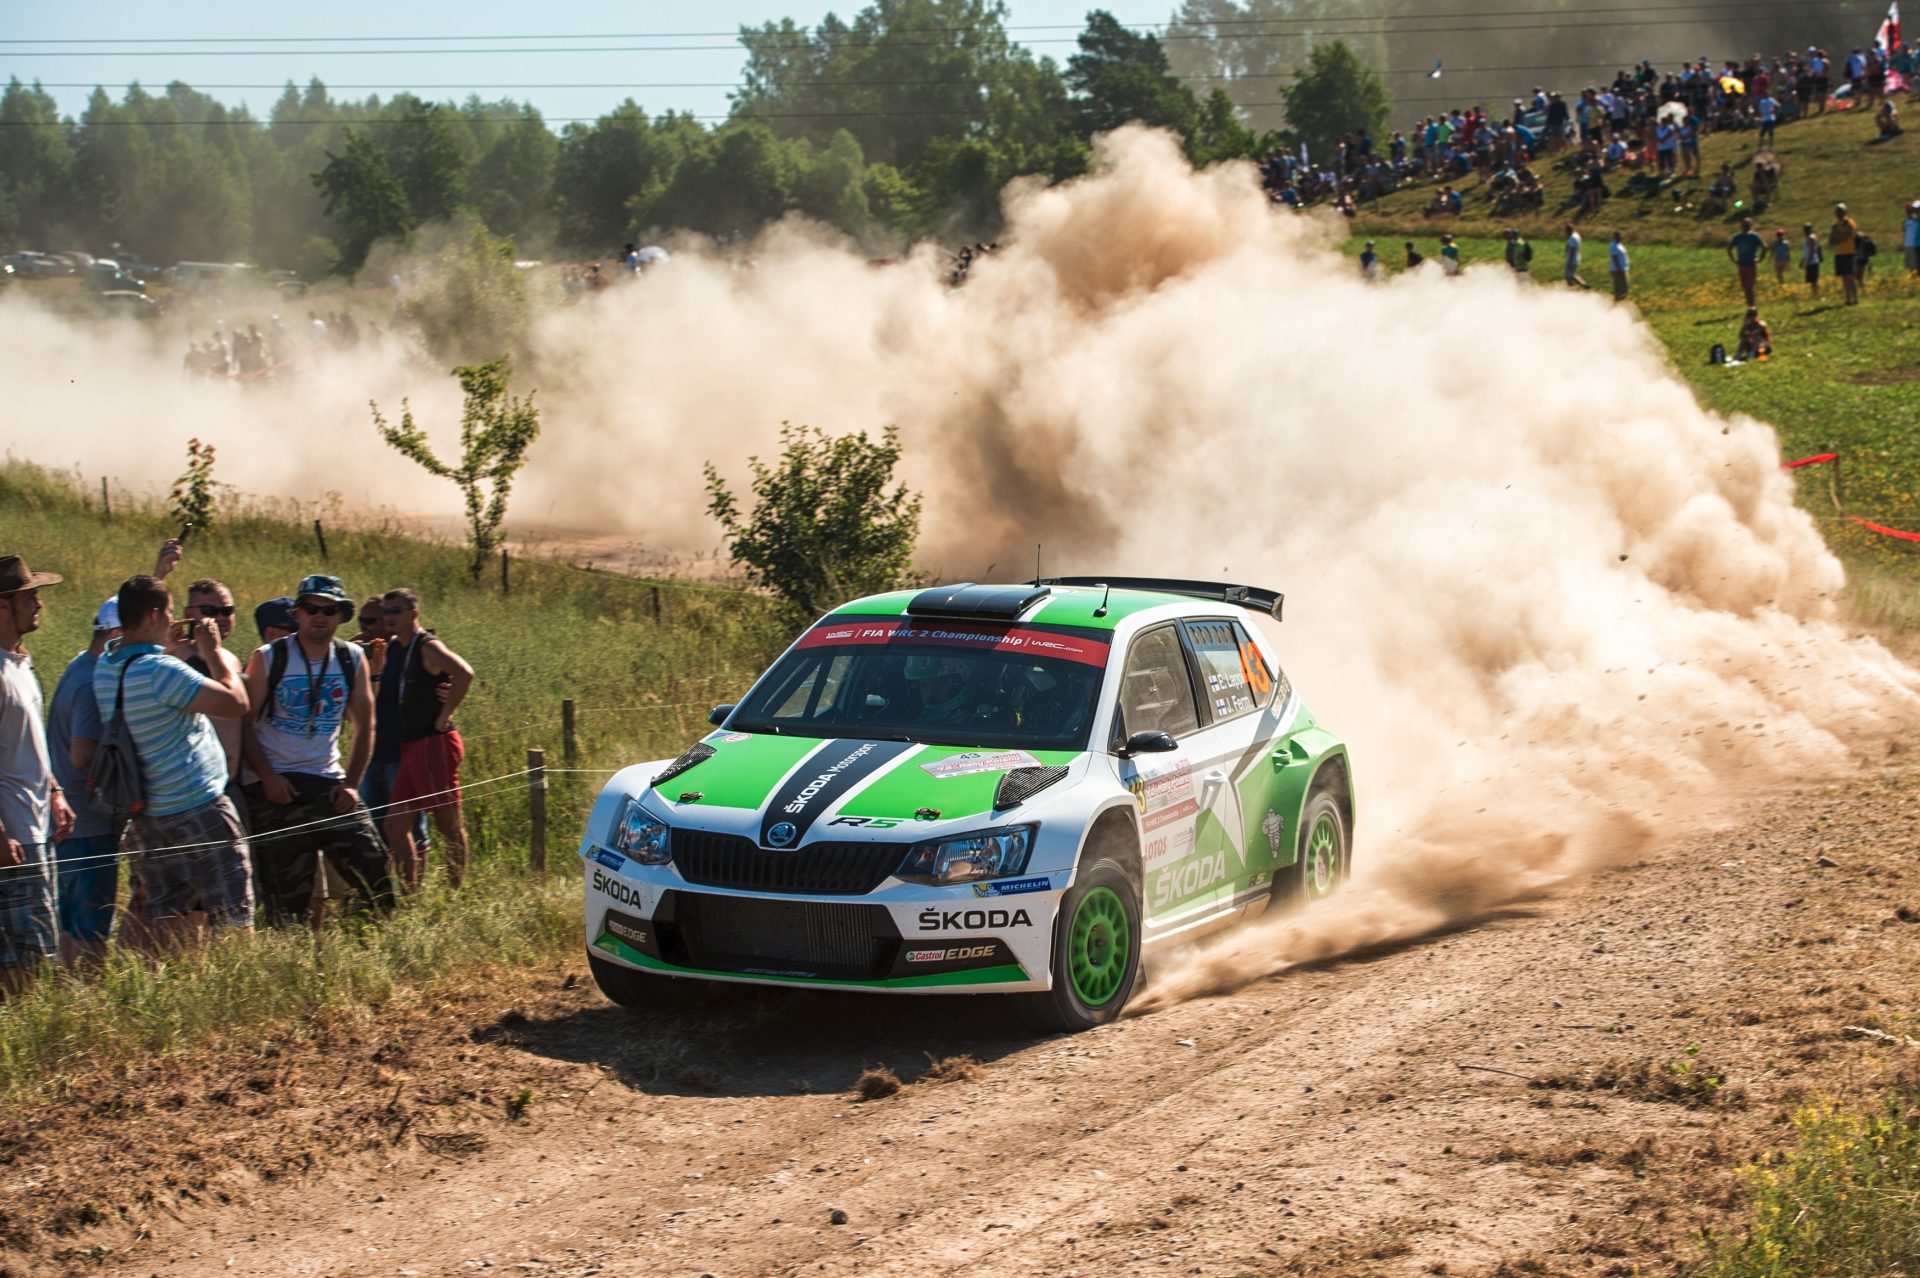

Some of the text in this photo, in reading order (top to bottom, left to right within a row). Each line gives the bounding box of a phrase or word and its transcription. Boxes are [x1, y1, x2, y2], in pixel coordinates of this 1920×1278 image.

[862, 629, 884, 637] FIA
[887, 629, 917, 637] WRC
[931, 630, 1023, 646] Championship
[960, 752, 981, 760] 43
[783, 743, 877, 813] ŠKODA Motorsport
[827, 816, 902, 829] R5
[1142, 836, 1168, 861] LOTOS
[1001, 880, 1049, 891] MICHELIN
[1154, 850, 1226, 908] ŠKODA
[593, 868, 642, 910] ŠKODA
[918, 907, 1033, 931] ŠKODA
[623, 927, 647, 943] EDGE
[915, 944, 997, 961] Castrol EDGE
